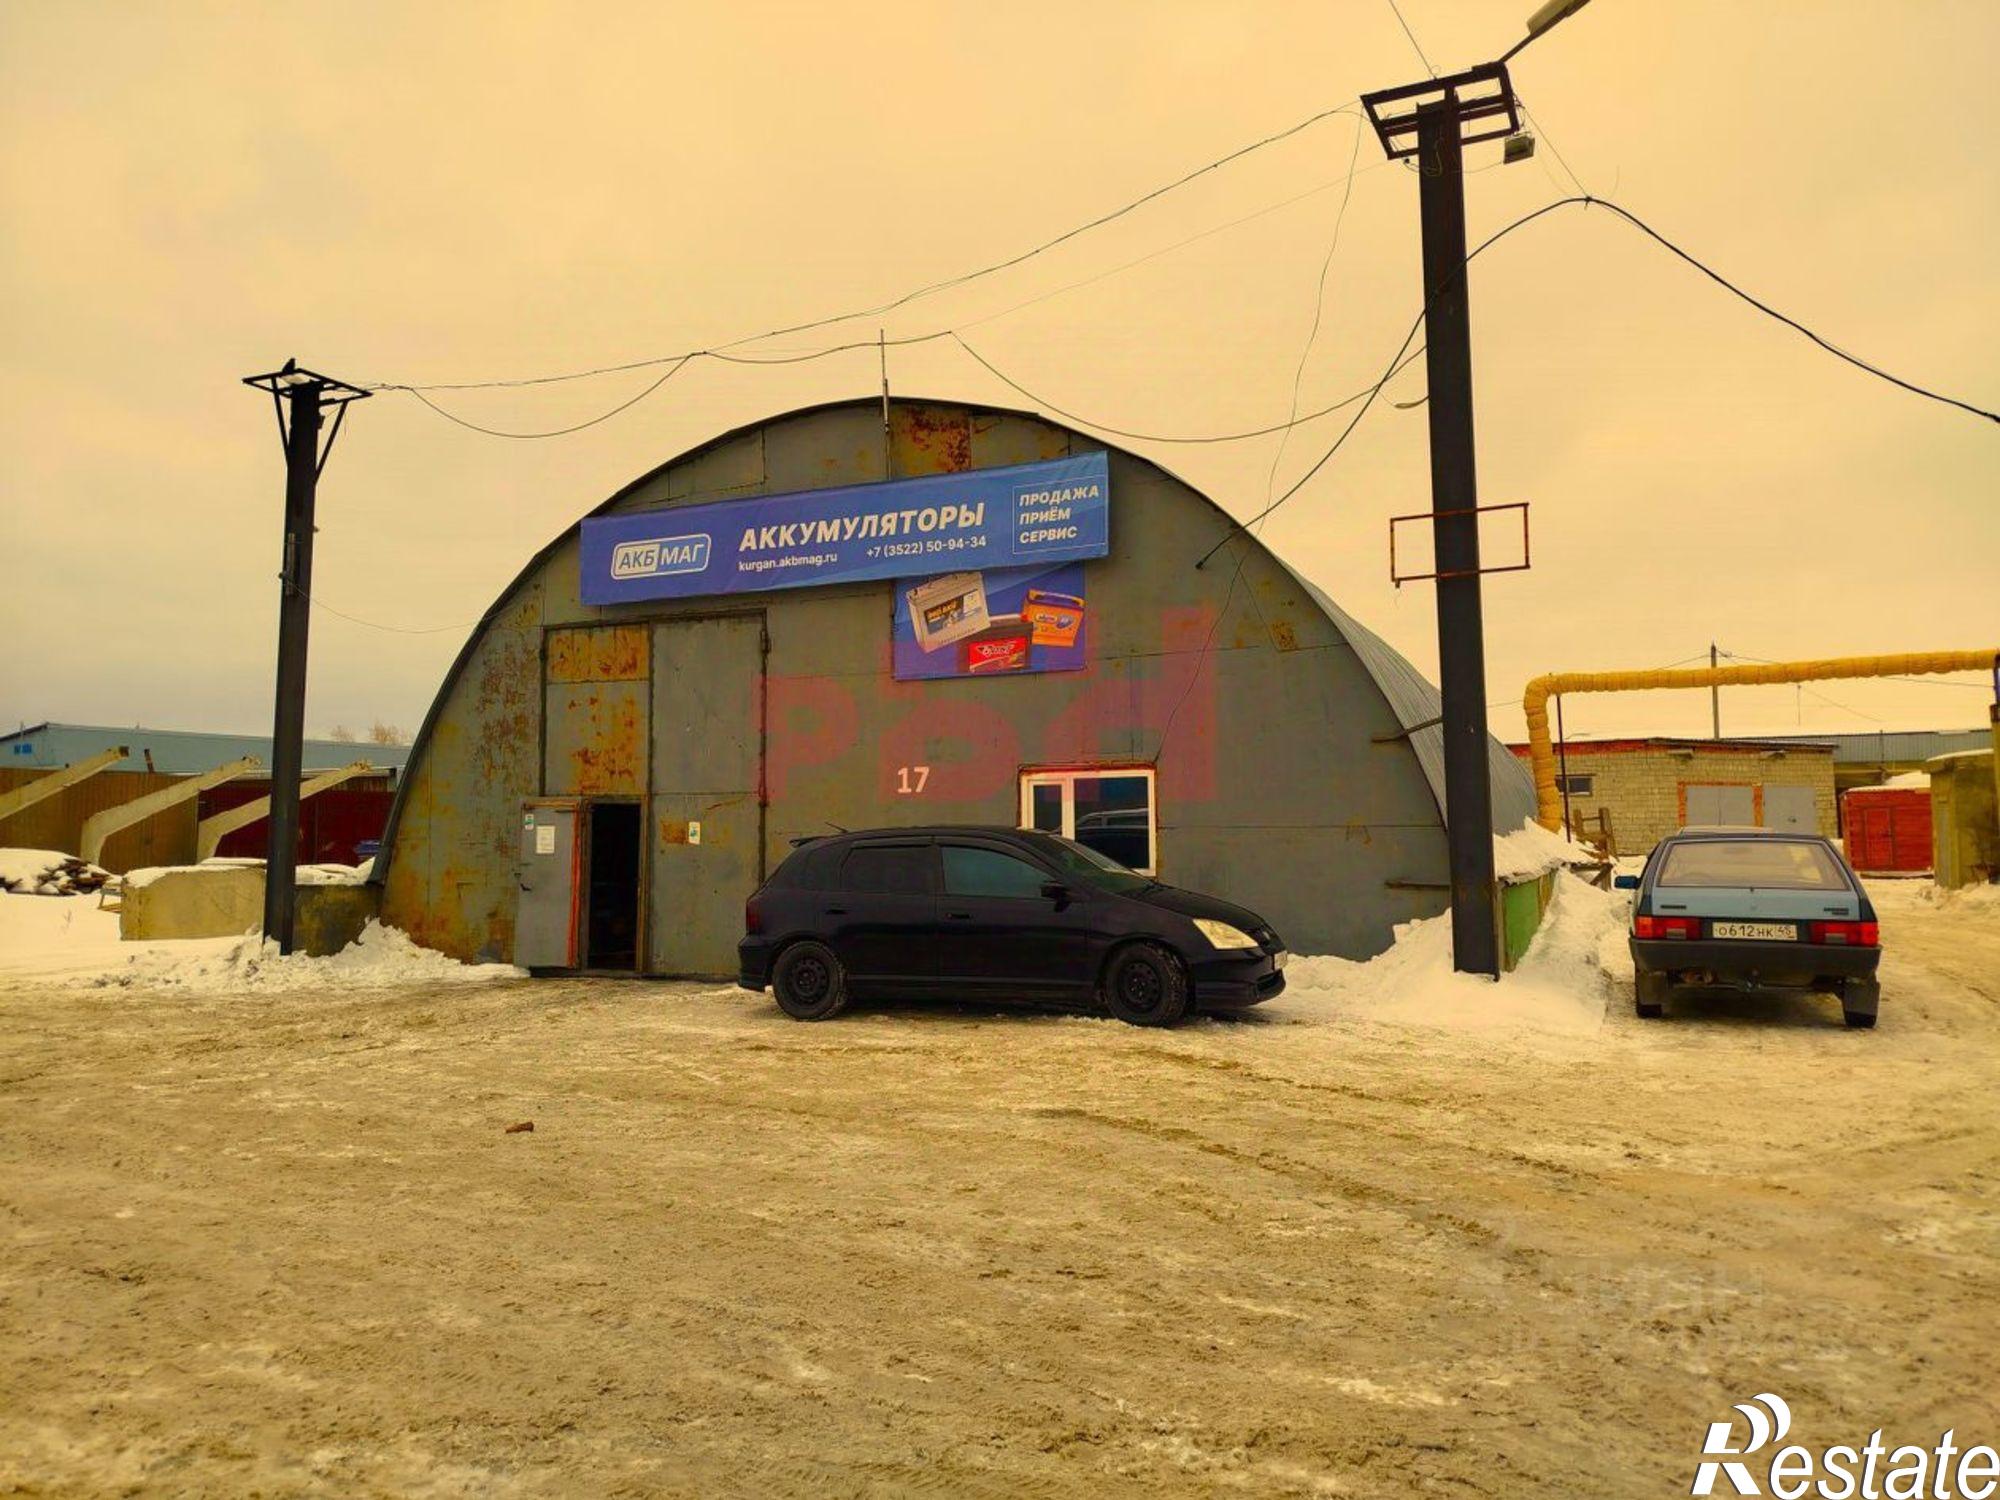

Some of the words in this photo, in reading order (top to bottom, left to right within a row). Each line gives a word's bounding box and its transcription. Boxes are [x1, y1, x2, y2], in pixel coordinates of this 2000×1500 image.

[1019, 485, 1100, 507] ПРОДАЖА
[1019, 506, 1072, 525] ПРИЁМ
[738, 502, 985, 552] АККУМУЛЯТОРЫ
[1019, 526, 1078, 544] СЕРВИС
[866, 546, 881, 558] +7
[883, 541, 923, 558] (3522)
[926, 535, 987, 552] 50-94-34
[738, 553, 838, 572] kurgan.akbmag.ru
[897, 766, 930, 793] 17
